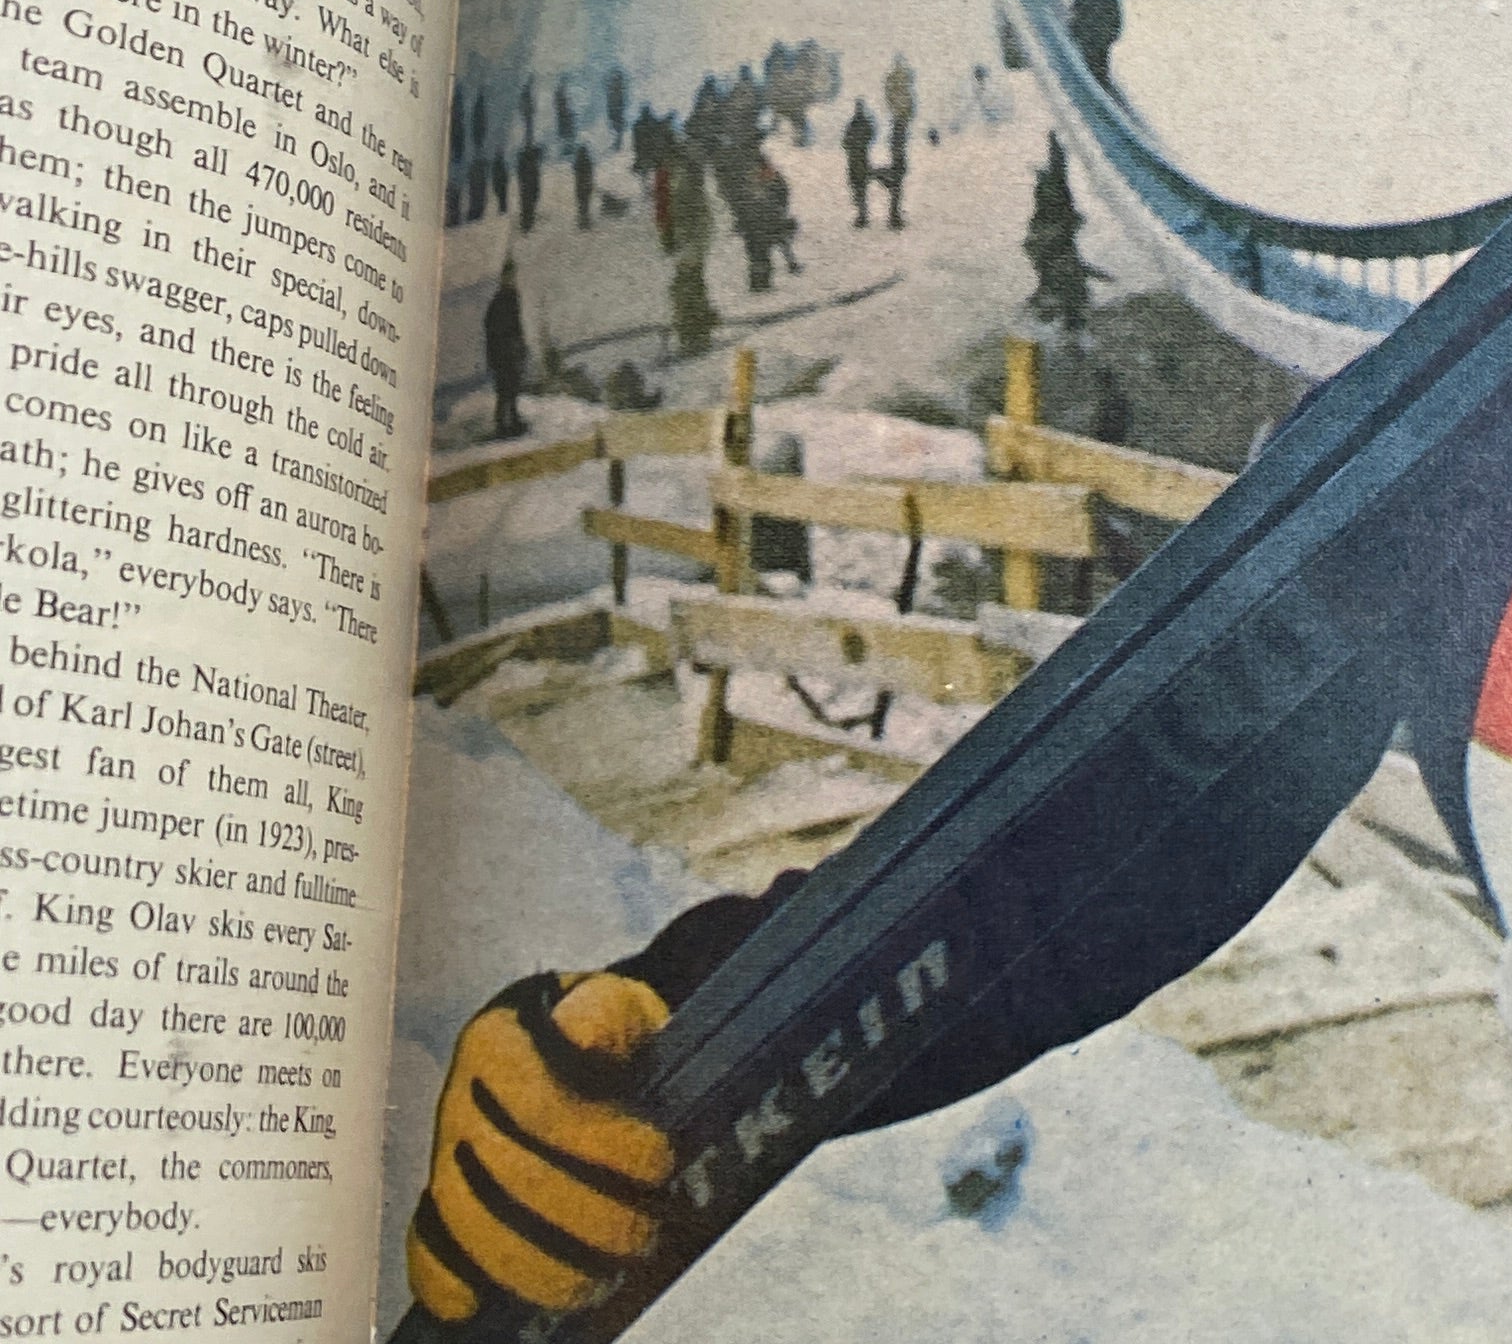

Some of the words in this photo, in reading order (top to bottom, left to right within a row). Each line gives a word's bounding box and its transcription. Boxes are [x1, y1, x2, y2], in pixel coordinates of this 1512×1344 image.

[213, 7, 255, 46] the
[317, 5, 370, 58] What
[64, 9, 185, 68] Golden
[203, 51, 303, 112] Quartet
[315, 102, 352, 136] and
[361, 122, 396, 157] the
[21, 47, 103, 91] team
[124, 78, 257, 139] assemble
[275, 124, 297, 157] in
[311, 141, 360, 191] Oslo,
[58, 105, 173, 159] though
[194, 147, 229, 176] all
[246, 160, 335, 218] 470,000
[104, 165, 171, 206] then
[189, 188, 232, 224] the
[242, 206, 336, 265] jumpers
[344, 254, 386, 290] come
[193, 238, 257, 279] their
[271, 265, 348, 320] special,
[105, 265, 233, 324] swagger,
[240, 302, 294, 340] caps
[299, 322, 357, 365] pulled
[360, 349, 397, 389] down
[10, 341, 99, 380] pride
[115, 361, 152, 393] all
[169, 374, 275, 426] through
[287, 406, 319, 440] the
[327, 422, 364, 458] cold
[45, 299, 123, 342] eyes,
[140, 320, 196, 354] and
[211, 336, 275, 378] there
[349, 383, 395, 435] feeling
[5, 392, 112, 432] comes
[129, 415, 167, 444] on
[184, 421, 232, 460] like
[2, 487, 151, 543] glittering
[168, 514, 288, 570] hardness.
[82, 448, 121, 482] he
[133, 460, 205, 500] gives
[216, 482, 254, 512] off
[296, 503, 356, 546] aurora
[119, 559, 262, 612] everybody
[269, 593, 317, 626] says.
[10, 636, 121, 679] behind
[137, 656, 180, 690] the
[193, 663, 298, 712] National
[62, 692, 132, 730] Karl
[251, 724, 303, 759] Gate
[87, 747, 136, 780] fan
[208, 767, 269, 800] them
[285, 779, 313, 811] all,
[327, 785, 364, 824] King
[98, 797, 206, 840] jumper
[215, 813, 248, 847] (in
[175, 858, 238, 891] skier
[246, 869, 286, 898] and
[35, 892, 114, 934] King
[130, 900, 196, 934] Olav
[209, 910, 254, 941] skis
[265, 924, 316, 953] every
[36, 946, 119, 979] miles
[176, 955, 239, 989] trails
[249, 966, 319, 997] around
[90, 998, 144, 1034] day
[162, 1004, 226, 1034] there
[239, 1013, 272, 1038] are
[3, 1046, 93, 1078] there.
[119, 1049, 244, 1088] Everyone
[258, 1063, 312, 1087] meets
[5, 1150, 137, 1185] Quartet,
[161, 1150, 201, 1181] the
[53, 1251, 133, 1289] royal
[159, 1247, 282, 1284] bodyguard
[297, 1245, 327, 1273] skis
[0, 1309, 60, 1338] sort
[120, 1301, 201, 1333] Secret
[214, 1294, 323, 1326] Serviceman
